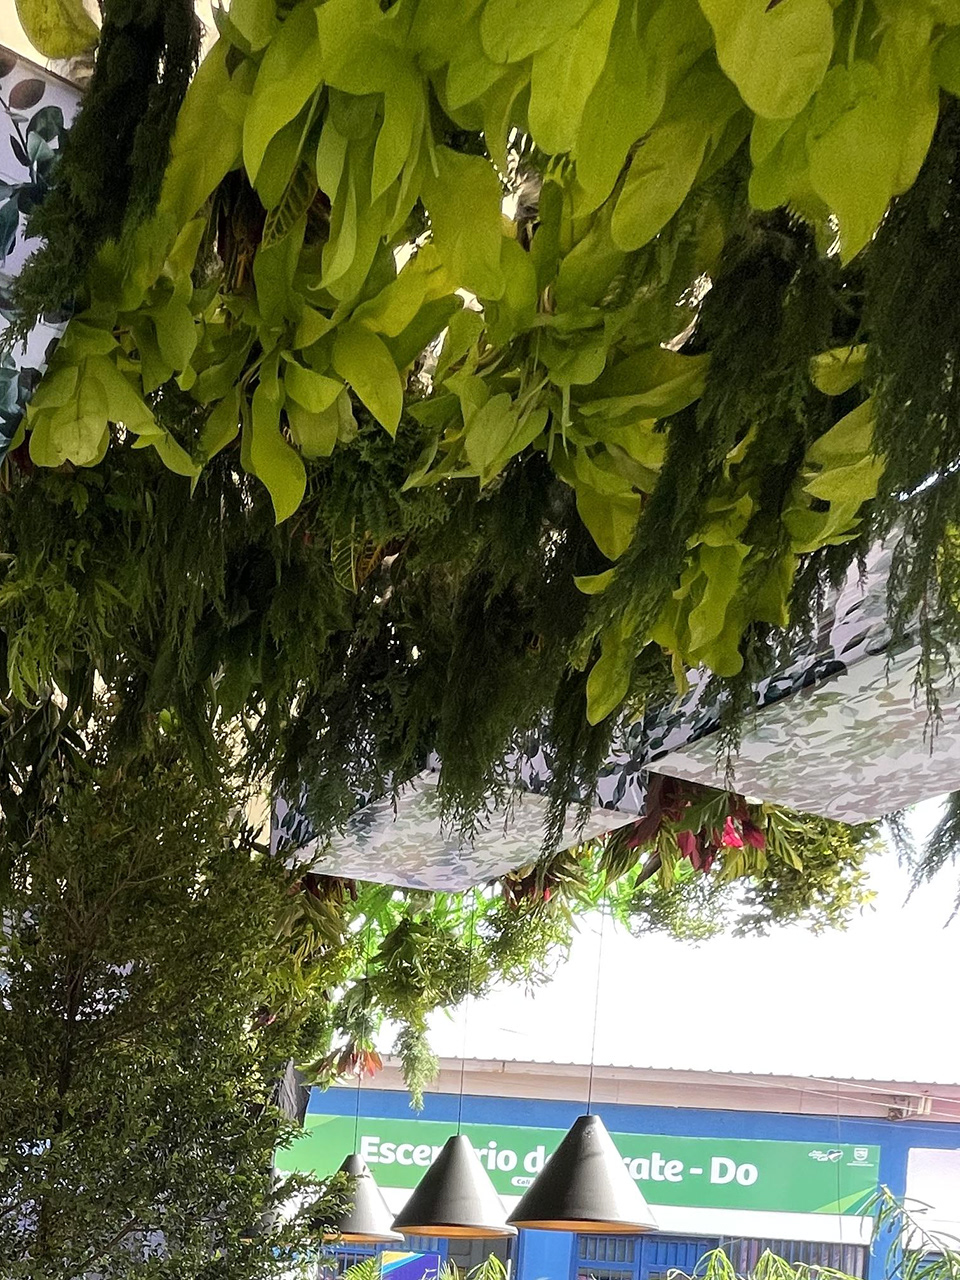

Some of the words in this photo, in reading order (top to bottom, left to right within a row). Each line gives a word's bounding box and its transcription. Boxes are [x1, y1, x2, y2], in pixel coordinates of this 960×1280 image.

[360, 1135, 518, 1172] Escerio
[523, 1145, 557, 1174] d
[710, 1156, 759, 1186] Do
